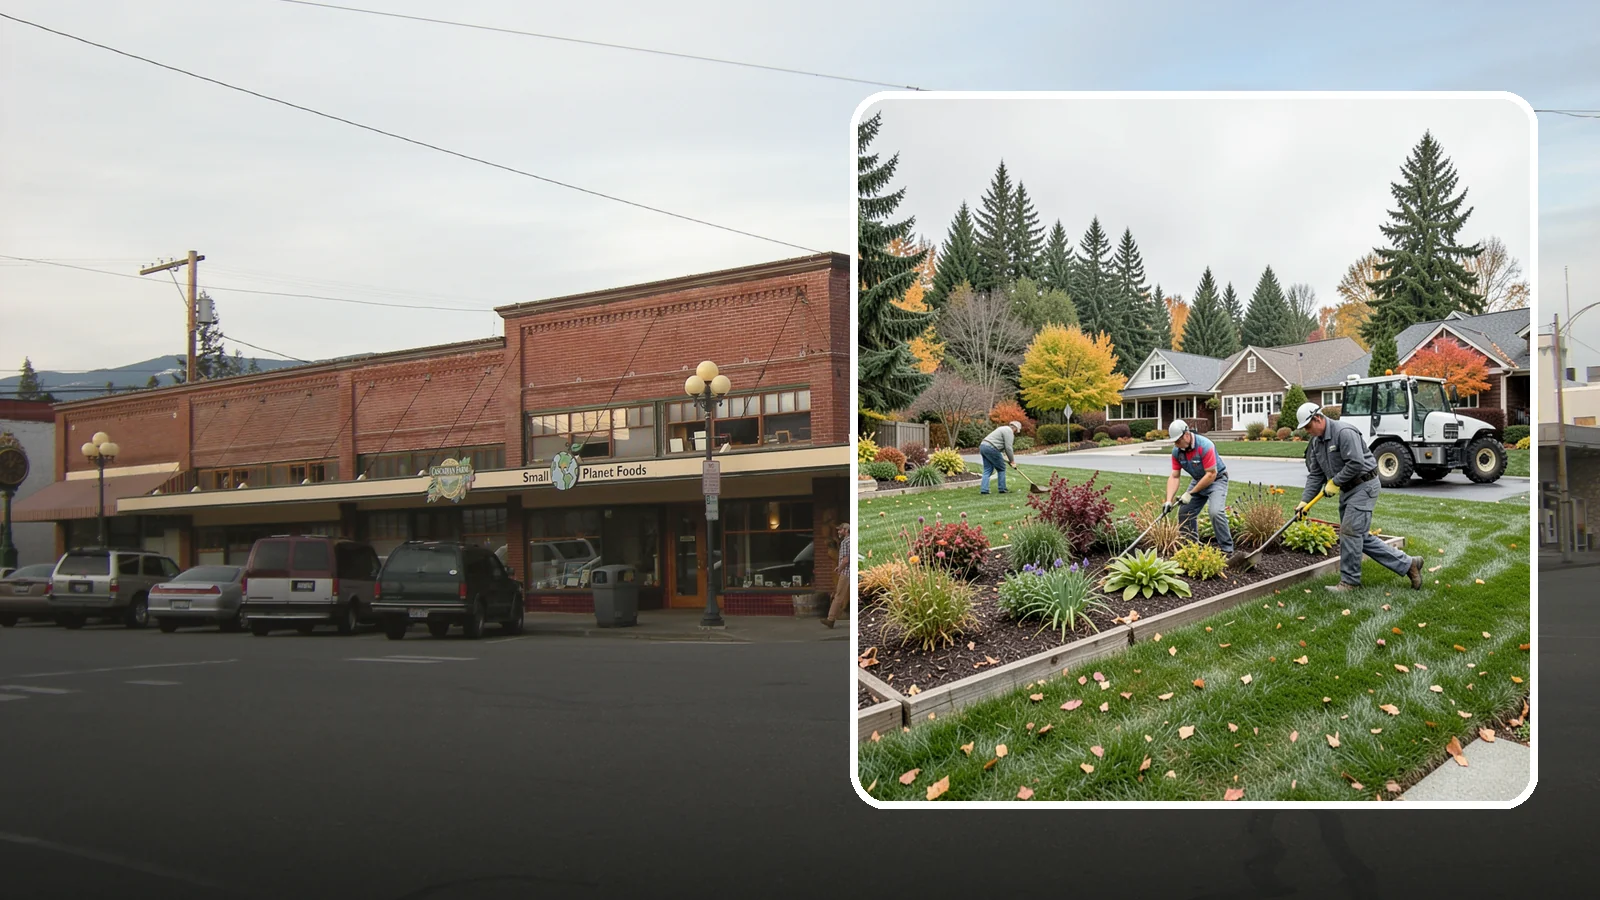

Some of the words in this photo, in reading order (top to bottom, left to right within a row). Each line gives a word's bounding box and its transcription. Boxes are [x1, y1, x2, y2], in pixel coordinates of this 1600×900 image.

[432, 467, 455, 476] CASCADIAN
[455, 466, 469, 474] FARM
[523, 471, 548, 483] Small
[583, 467, 614, 479] Planet
[617, 464, 647, 477] Foods
